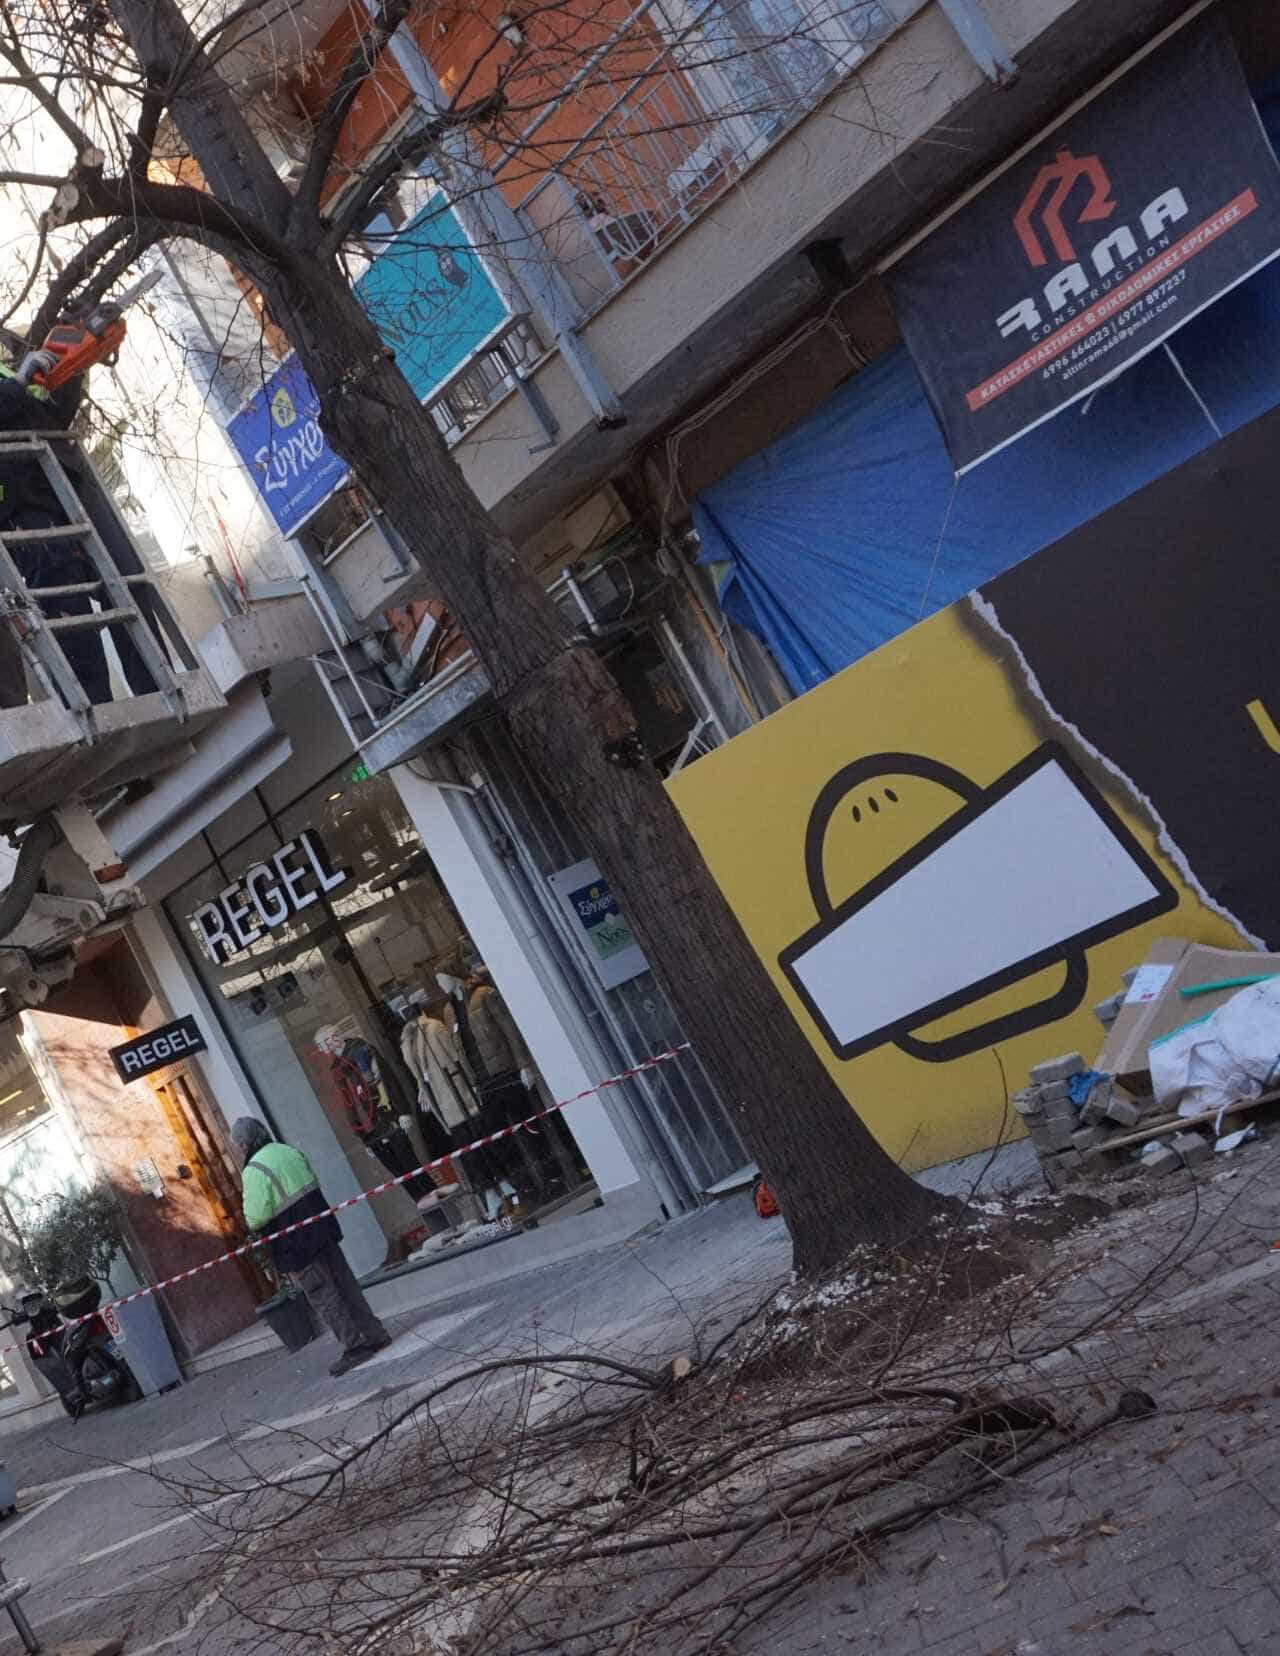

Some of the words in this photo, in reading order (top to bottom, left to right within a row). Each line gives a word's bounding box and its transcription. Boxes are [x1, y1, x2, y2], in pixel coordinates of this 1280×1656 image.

[980, 324, 1085, 399] ΚΑΤΑΣΚΕΥΑΣΤΙΚΕΣ
[1098, 251, 1180, 318] ΟΙΚΟΔΟΜΙΚΕΣ
[1182, 205, 1241, 255] ΕΡΓΑΣΙΕΣ
[995, 186, 1189, 338] RAMA
[1031, 237, 1170, 342] CONSTRUCTION
[1042, 356, 1069, 378] 6996
[1118, 304, 1146, 327] 6977
[1146, 269, 1187, 305] 897237
[193, 832, 346, 965] REGEL
[120, 1027, 200, 1073] REGEL
